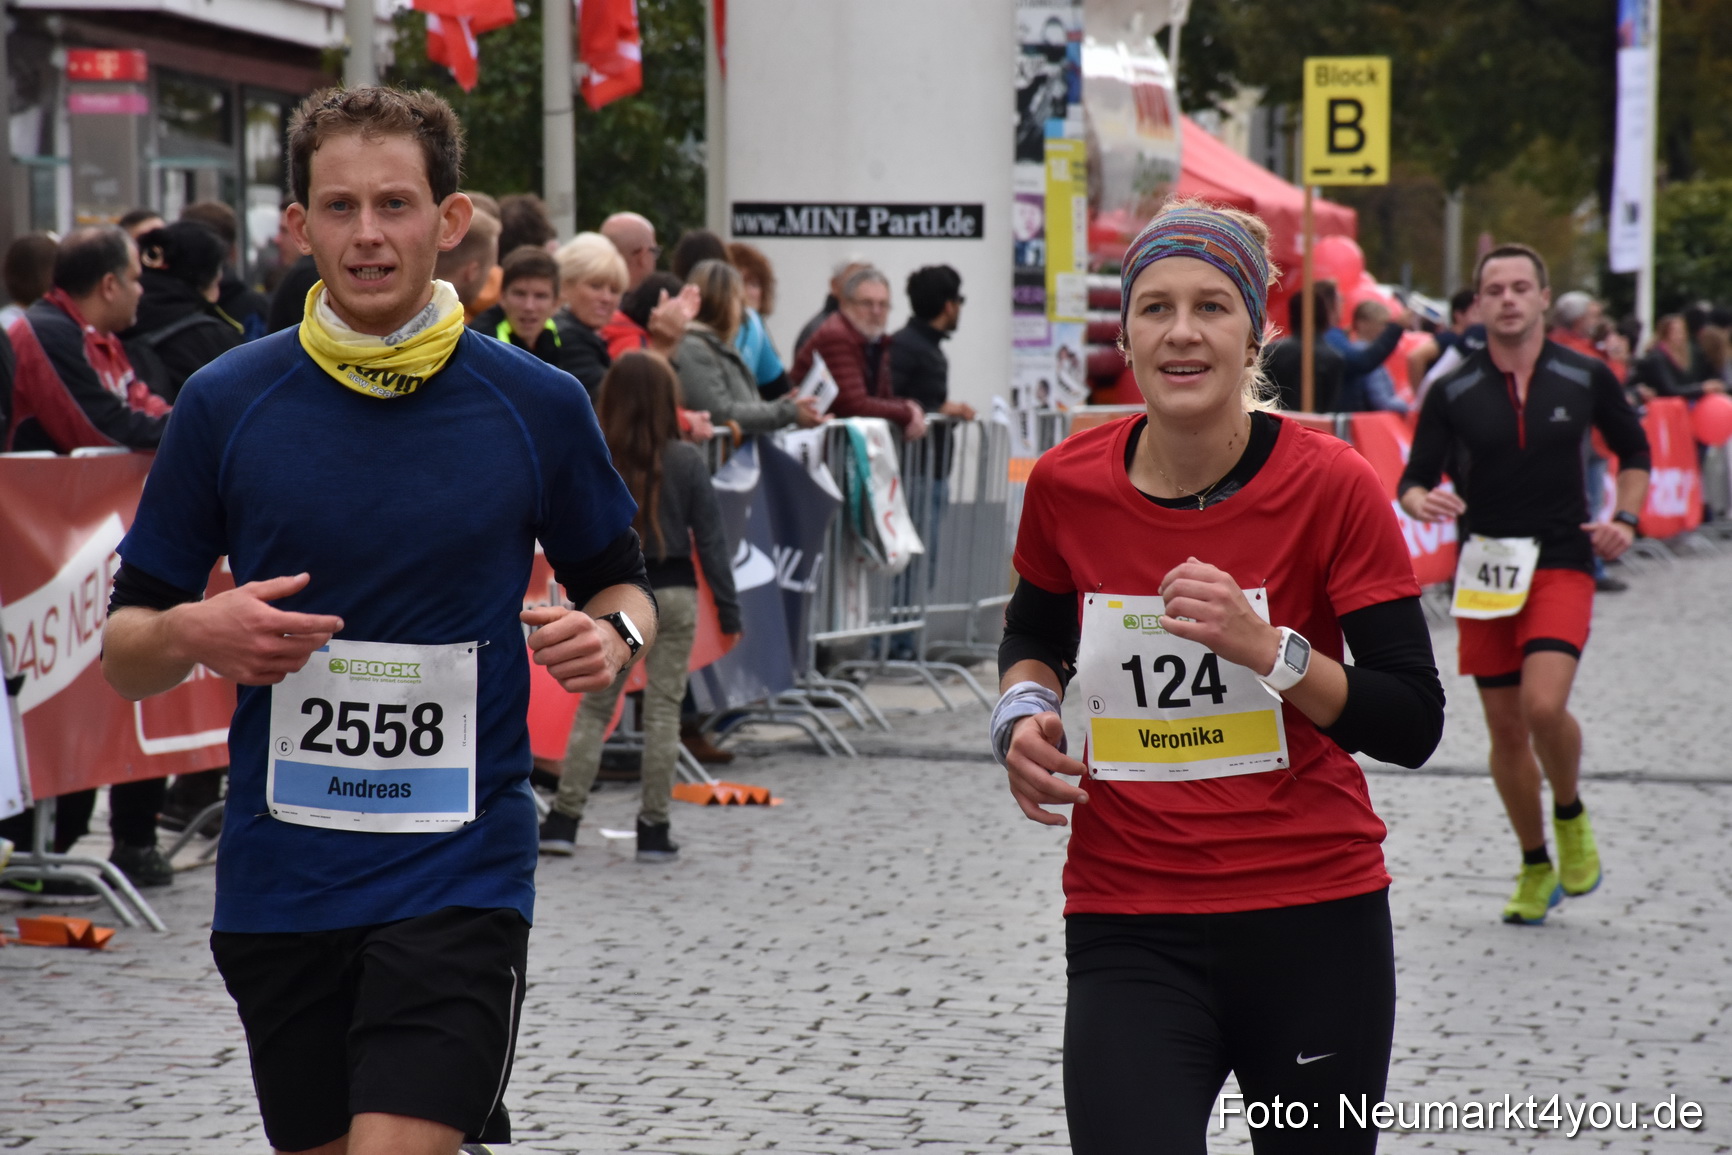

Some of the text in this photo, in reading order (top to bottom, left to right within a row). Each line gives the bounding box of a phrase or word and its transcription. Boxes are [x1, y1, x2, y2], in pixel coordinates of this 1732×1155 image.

[1315, 64, 1379, 87] Block
[1327, 98, 1366, 154] B
[347, 372, 369, 388] new
[1477, 562, 1520, 590] 417
[350, 659, 421, 678] BOCK
[1121, 653, 1227, 708] 124
[1093, 700, 1100, 710] D
[300, 697, 444, 758] 2558
[1138, 726, 1224, 749] Veronika
[281, 741, 288, 752] C
[327, 776, 412, 799] Andreas
